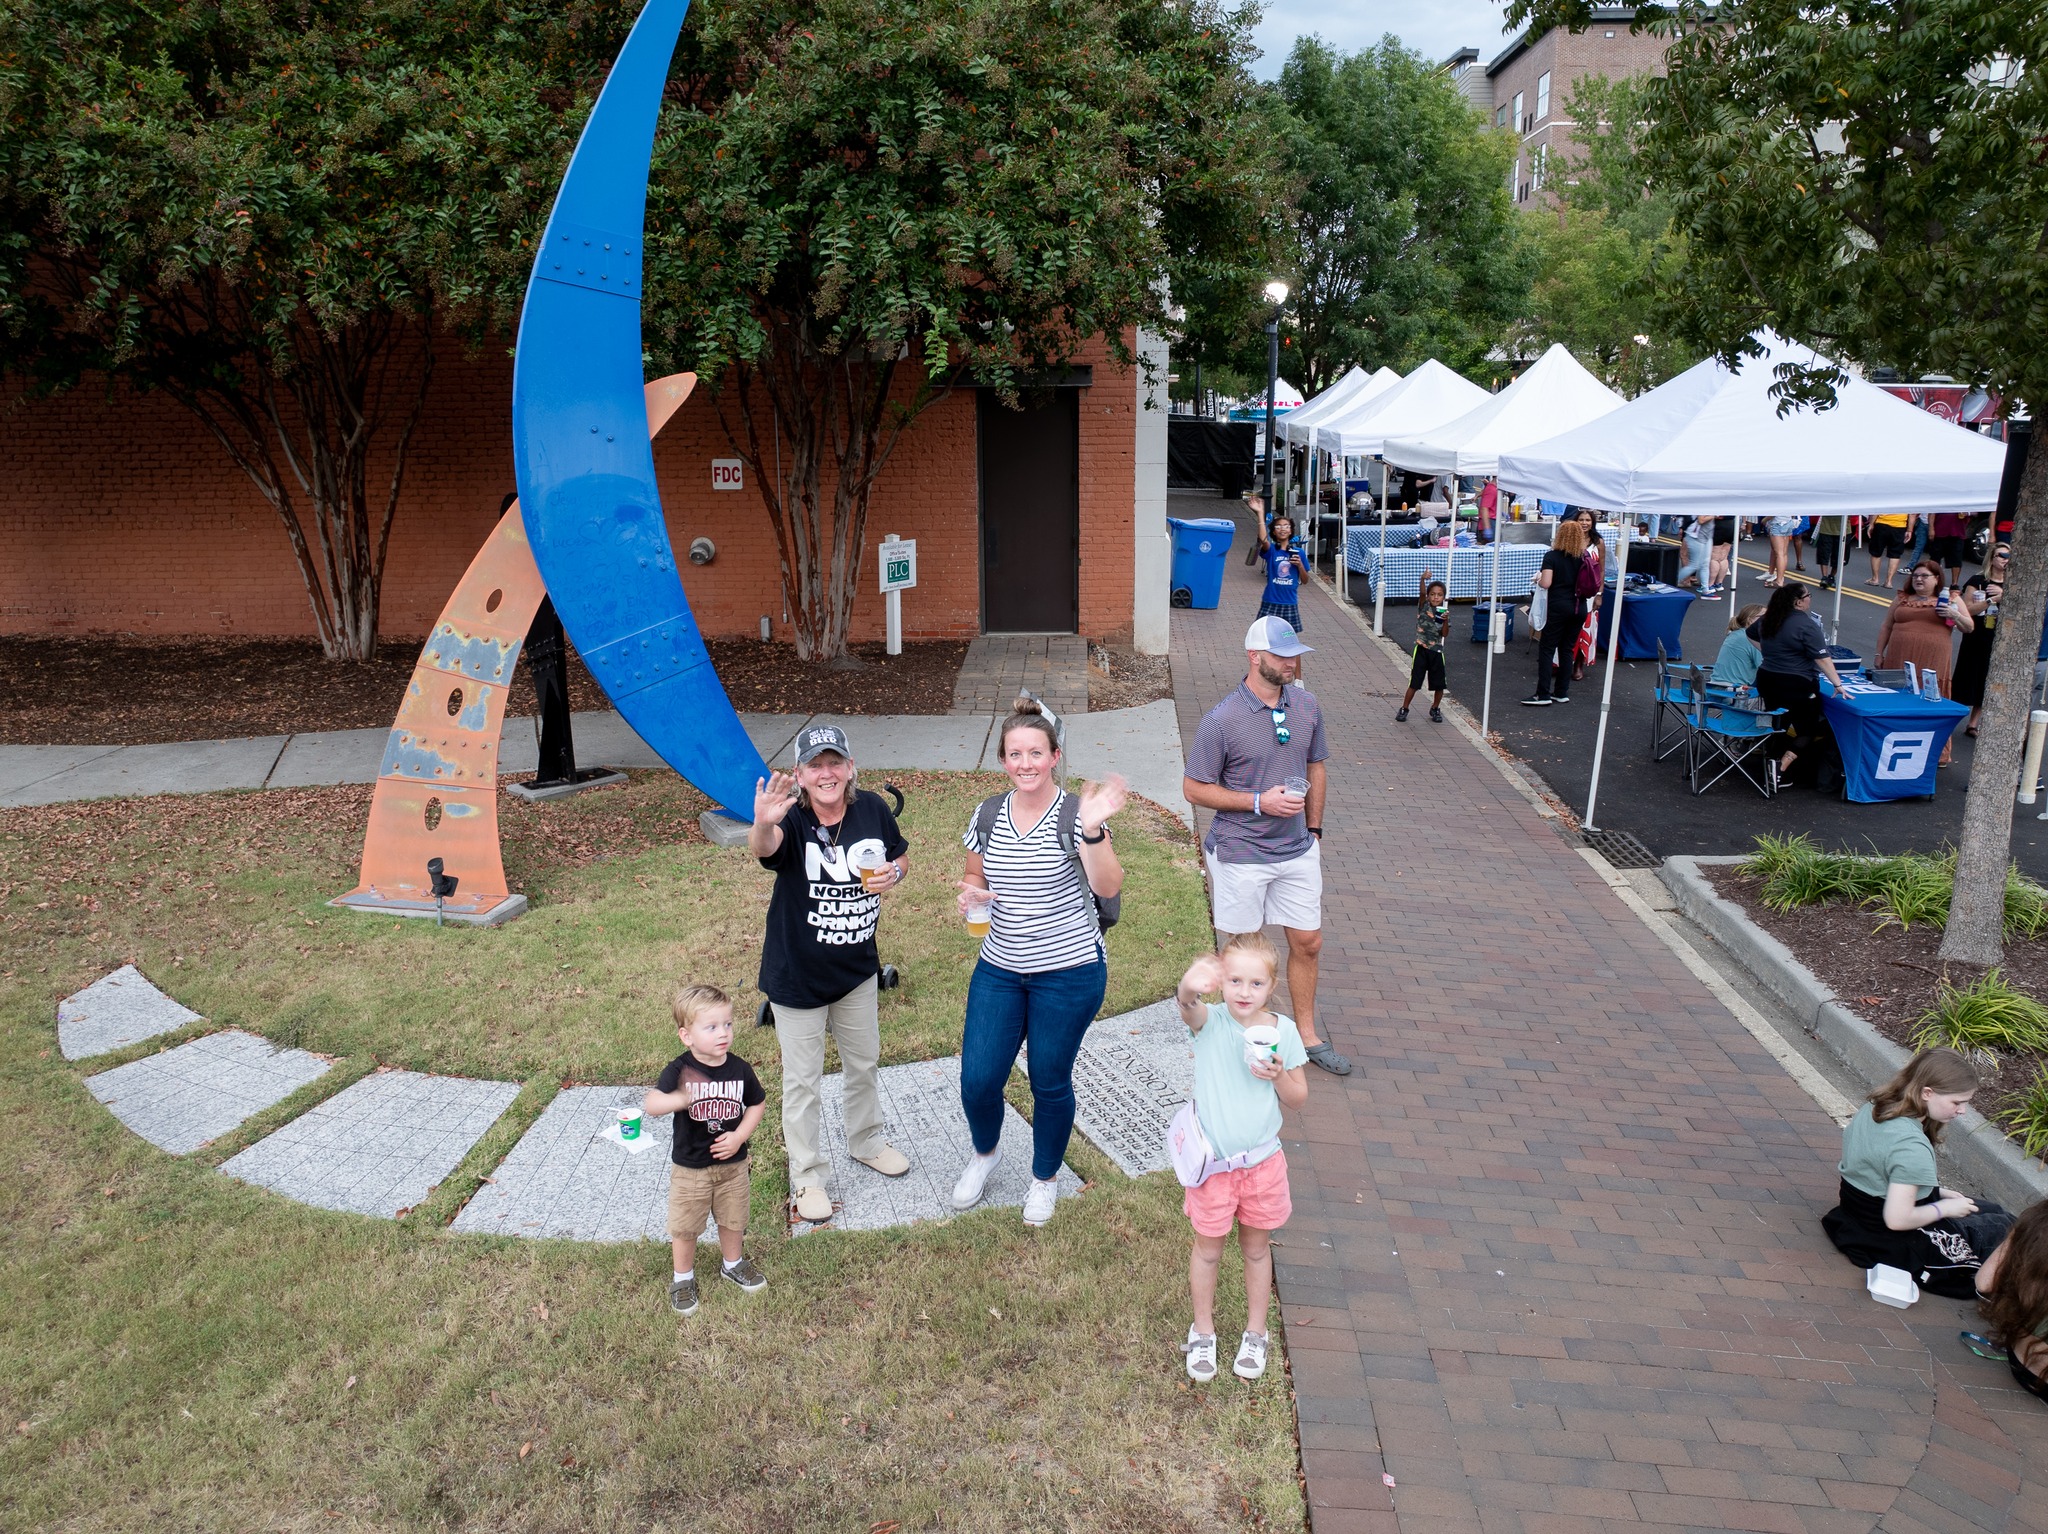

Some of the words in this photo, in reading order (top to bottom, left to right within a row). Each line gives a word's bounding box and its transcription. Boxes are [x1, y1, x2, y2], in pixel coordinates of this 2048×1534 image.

[713, 466, 742, 483] FDC
[889, 562, 908, 578] PLC
[809, 737, 837, 746] BEER
[813, 886, 870, 898] WORK
[818, 894, 880, 915] DURING
[807, 908, 880, 930] DRINKIN
[817, 923, 875, 945] HOURS
[1074, 1055, 1098, 1076] MINDE
[1104, 1044, 1188, 1109] FLORENCE
[685, 1080, 744, 1103] CAROLINA
[1071, 1068, 1119, 1111] CONTRIBUTIO
[1094, 1079, 1143, 1118] COMMUNITY
[688, 1099, 741, 1122] GAMECOCKS
[1080, 1094, 1120, 1128] POSSIBLE
[1123, 1090, 1171, 1129] PORATIONS
[1088, 1118, 1101, 1126] IN
[1116, 1113, 1163, 1151] GENEROUS
[1139, 1118, 1168, 1141] THESE
[1097, 1128, 1118, 1142] ART
[1116, 1128, 1144, 1150] MADE
[1114, 1144, 1147, 1172] PUBLIC
[1140, 1150, 1155, 1160] IS
